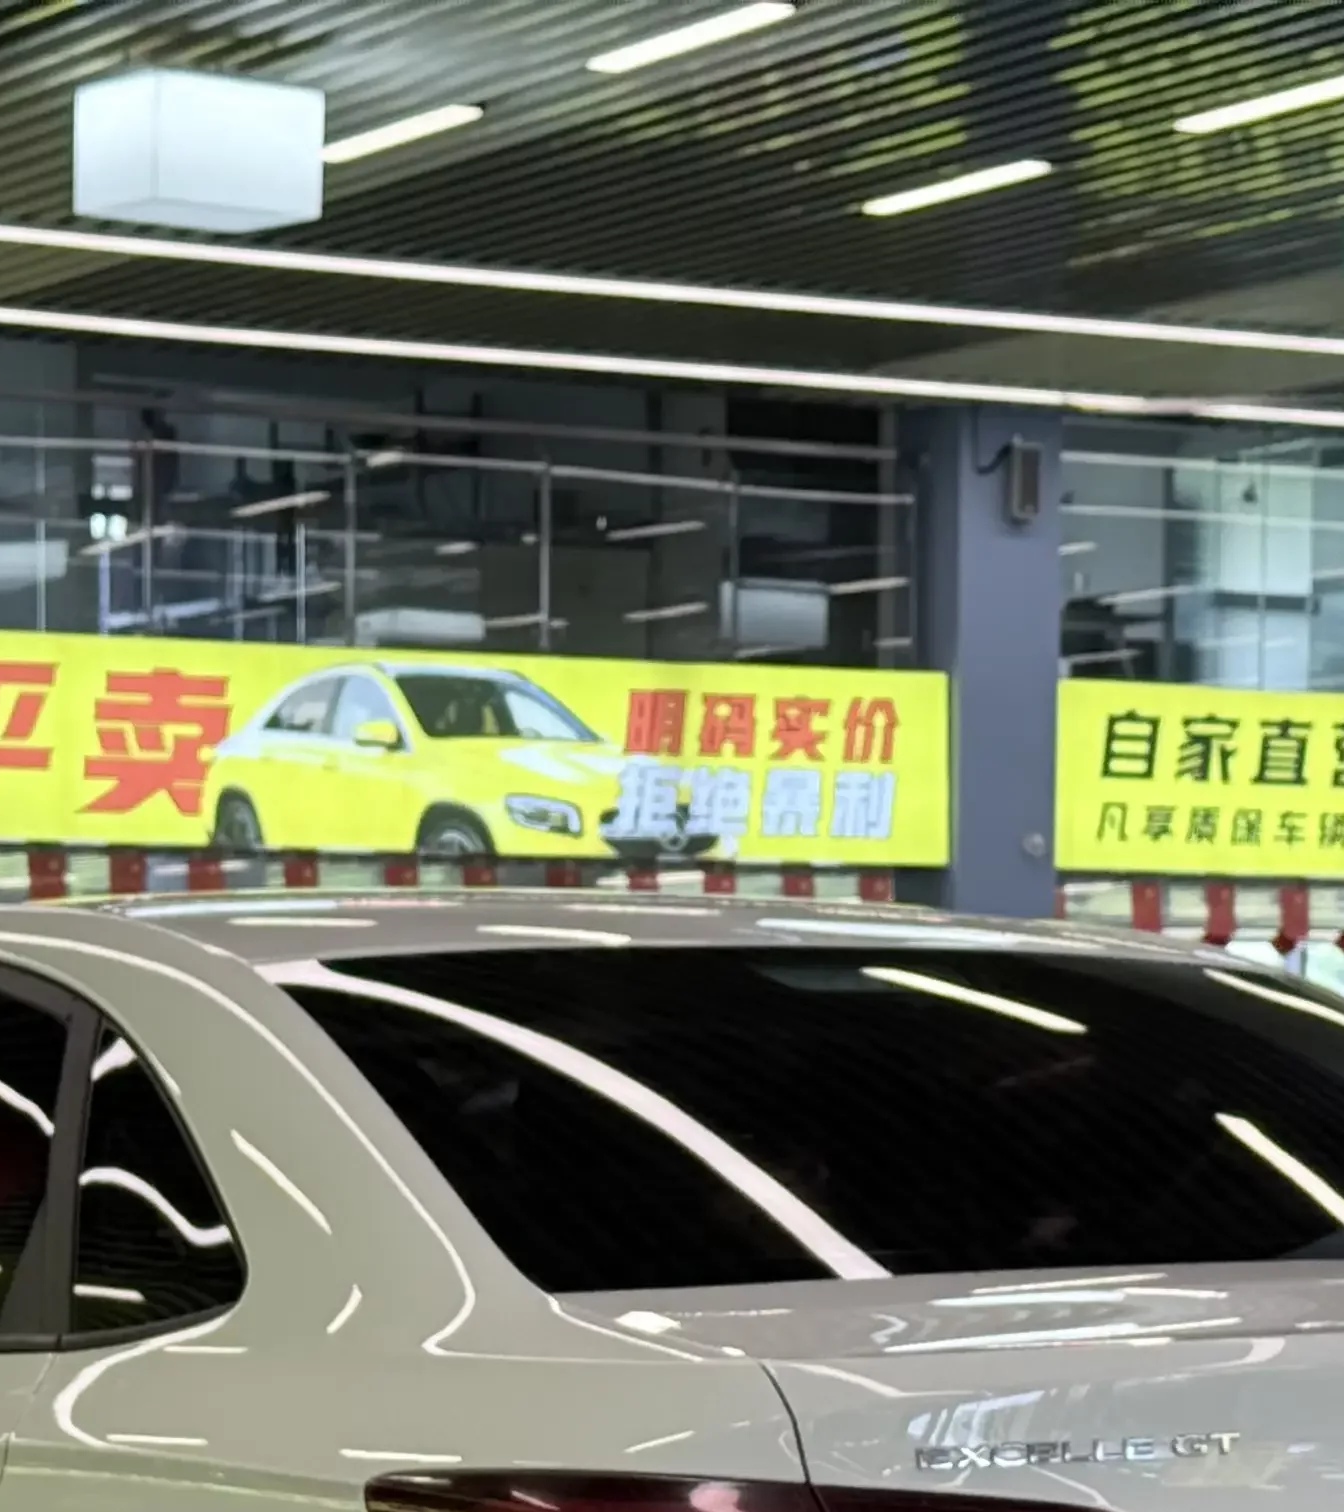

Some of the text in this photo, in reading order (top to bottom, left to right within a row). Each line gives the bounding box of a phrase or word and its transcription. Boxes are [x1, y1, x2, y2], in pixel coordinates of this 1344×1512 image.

[623, 688, 899, 763] 明码实价
[608, 764, 896, 838] 拒绝暴利
[915, 1431, 1240, 1470] EXCELLE GT
